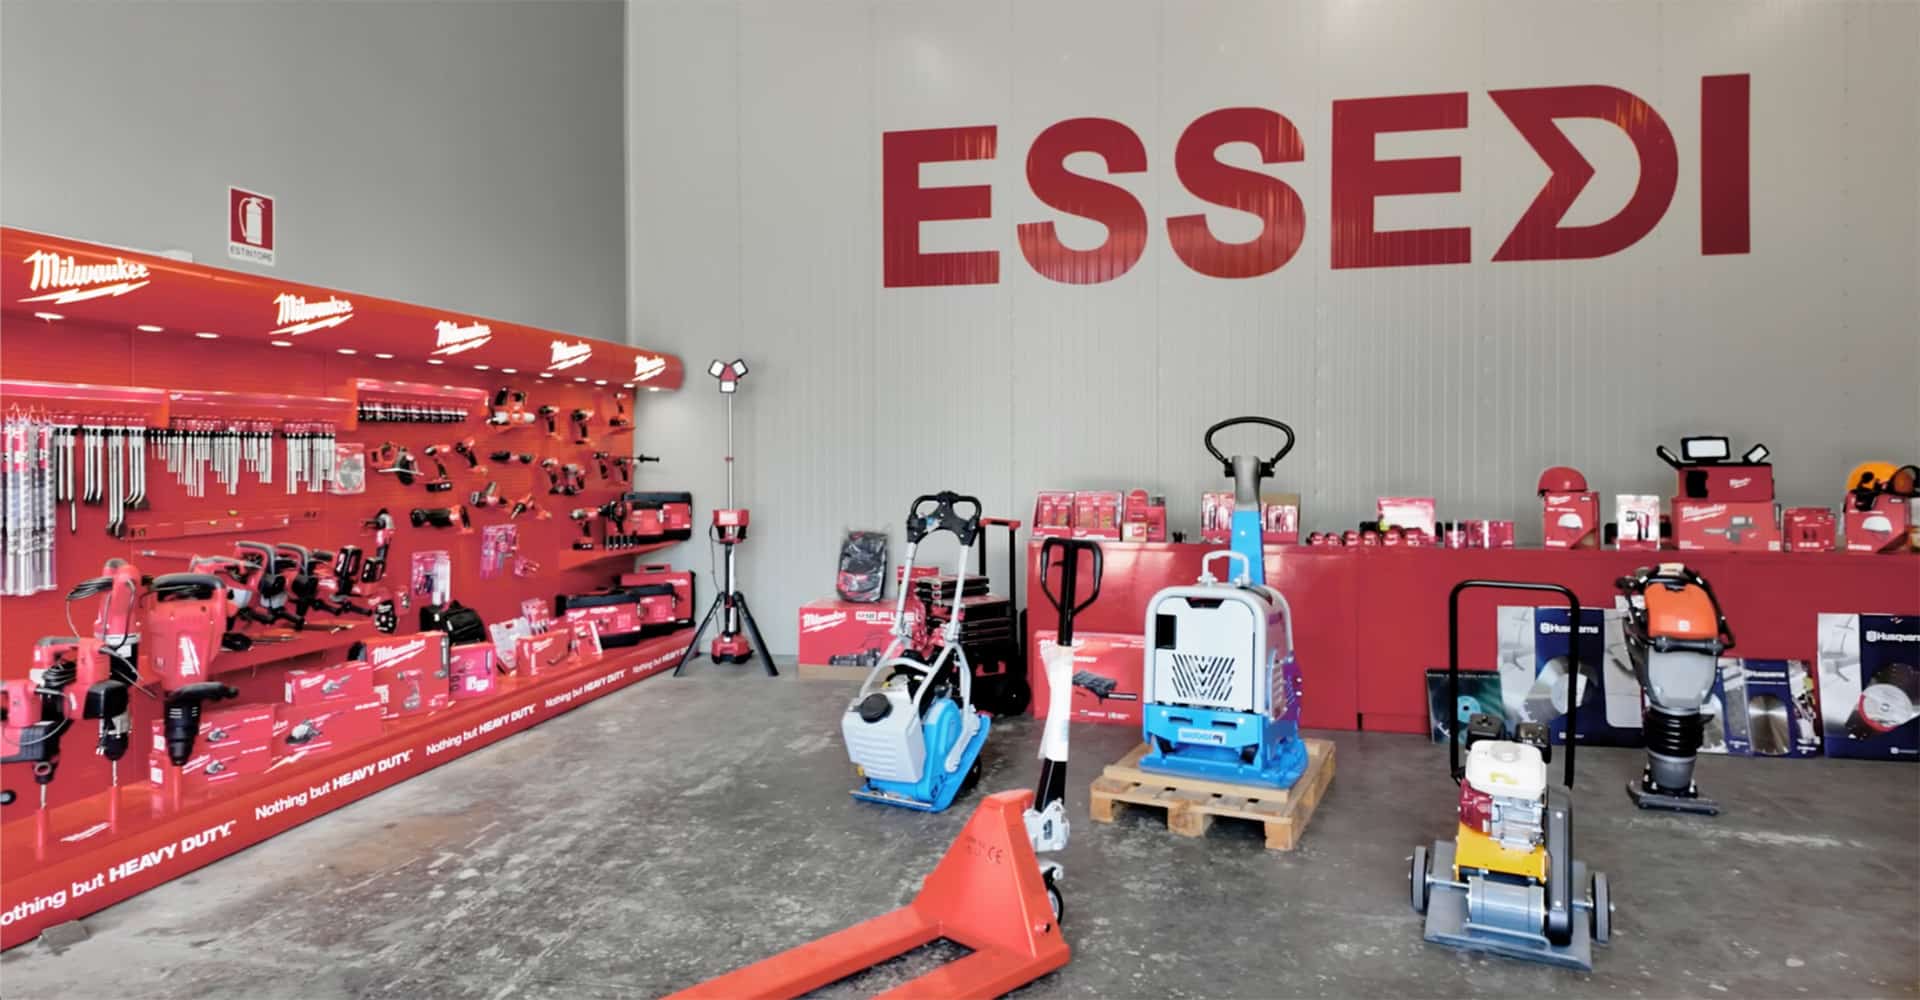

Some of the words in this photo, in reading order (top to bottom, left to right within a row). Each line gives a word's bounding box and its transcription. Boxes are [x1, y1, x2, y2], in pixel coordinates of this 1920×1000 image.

[883, 74, 1750, 287] ESSEDI
[23, 250, 150, 291] Milwaukee
[273, 292, 353, 326] Milwaukee
[426, 734, 462, 756] Nothing
[463, 727, 478, 741] but
[479, 715, 511, 736] HEAVY
[255, 792, 308, 821] Nothing
[309, 781, 330, 800] but
[332, 764, 377, 791] HEAVY
[0, 889, 67, 926] othing
[71, 873, 104, 898] but
[108, 843, 178, 882] HEAVY
